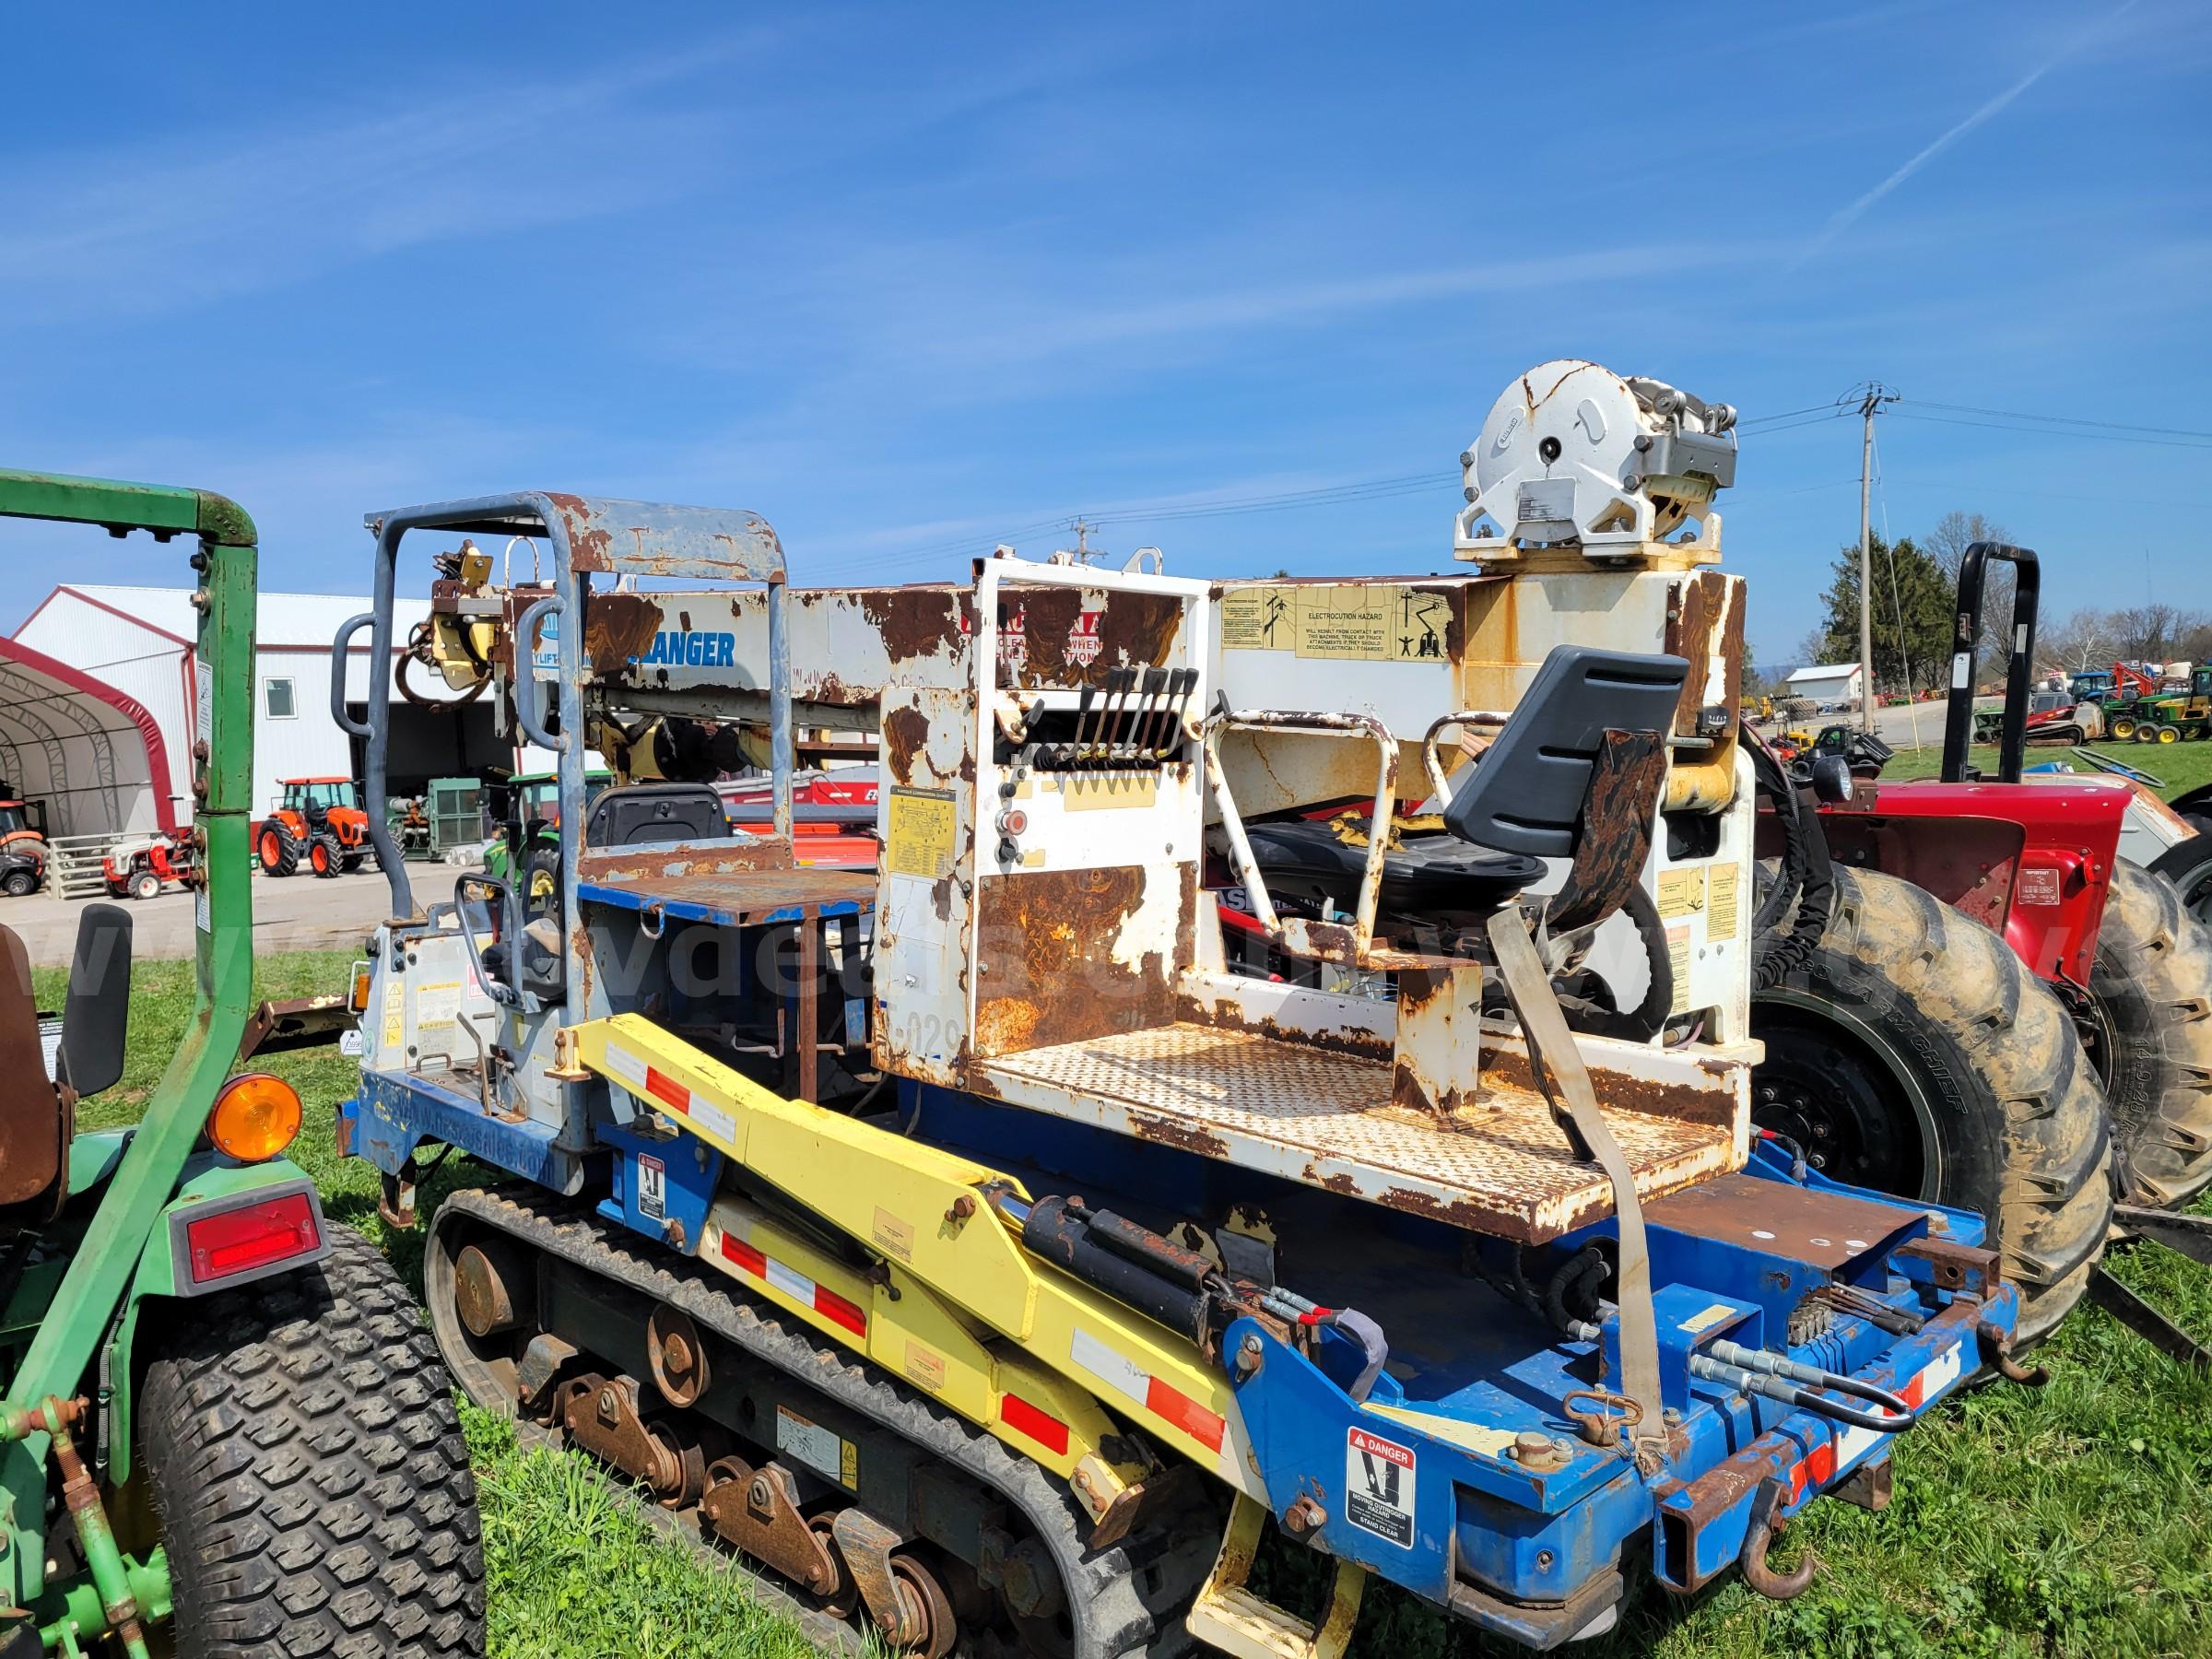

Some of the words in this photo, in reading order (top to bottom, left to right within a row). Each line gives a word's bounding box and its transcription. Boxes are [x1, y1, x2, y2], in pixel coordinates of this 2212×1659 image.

[628, 631, 735, 666] ANGER
[1837, 975, 1916, 1033] FARM
[1910, 1033, 1969, 1115] CHIEF
[2130, 1039, 2152, 1114] 14.9-28
[1369, 1439, 1408, 1465] DANGER
[1352, 1493, 1373, 1506] MOVING
[1374, 1502, 1406, 1521] OUTRIGGER
[1368, 1505, 1390, 1519] HAZARD
[1360, 1516, 1379, 1529] STAND
[1380, 1524, 1399, 1537] CLEAR
